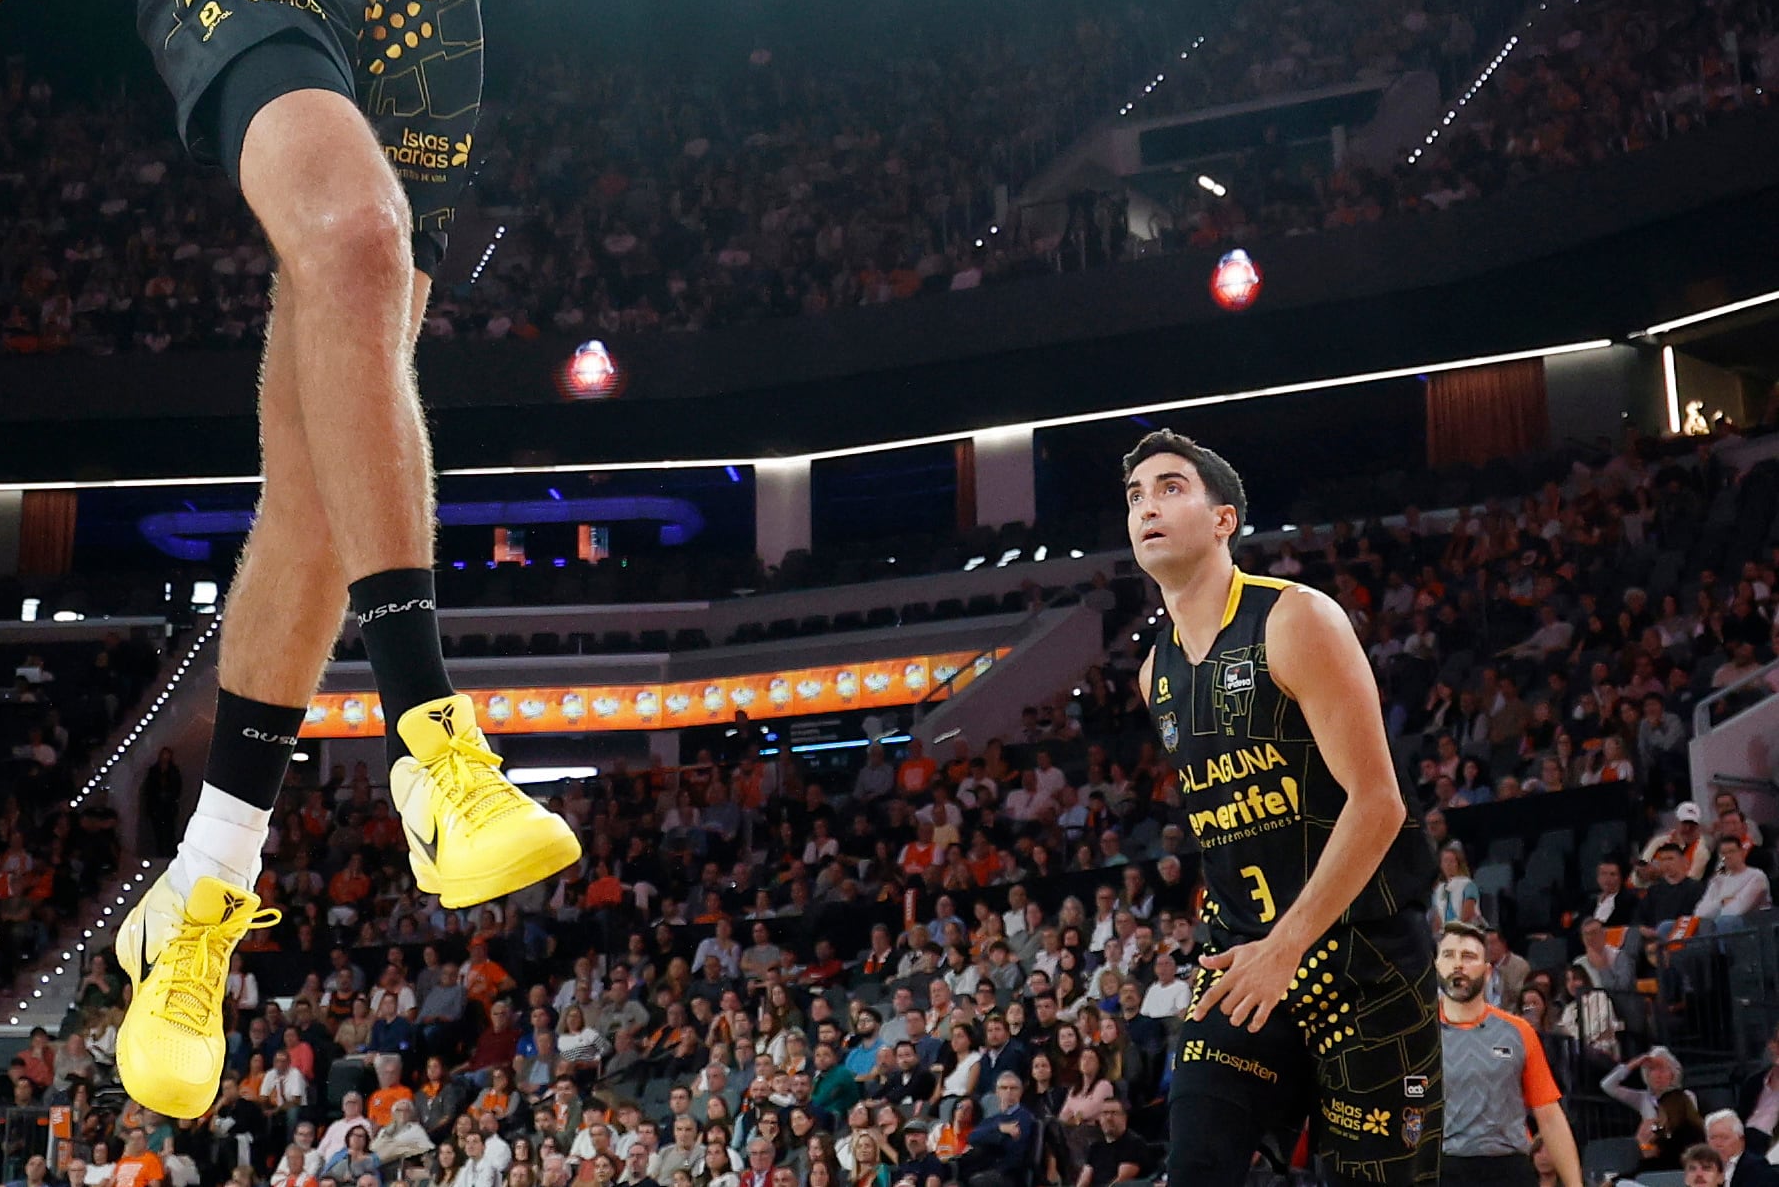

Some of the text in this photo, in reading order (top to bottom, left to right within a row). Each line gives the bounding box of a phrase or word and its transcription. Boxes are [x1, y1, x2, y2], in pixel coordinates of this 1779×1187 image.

[403, 127, 450, 152] Islas
[1188, 743, 1288, 792] LAGUNA
[1189, 776, 1302, 837] enerife!
[1206, 1048, 1279, 1084] Hospiten
[1331, 1097, 1362, 1119] Islas
